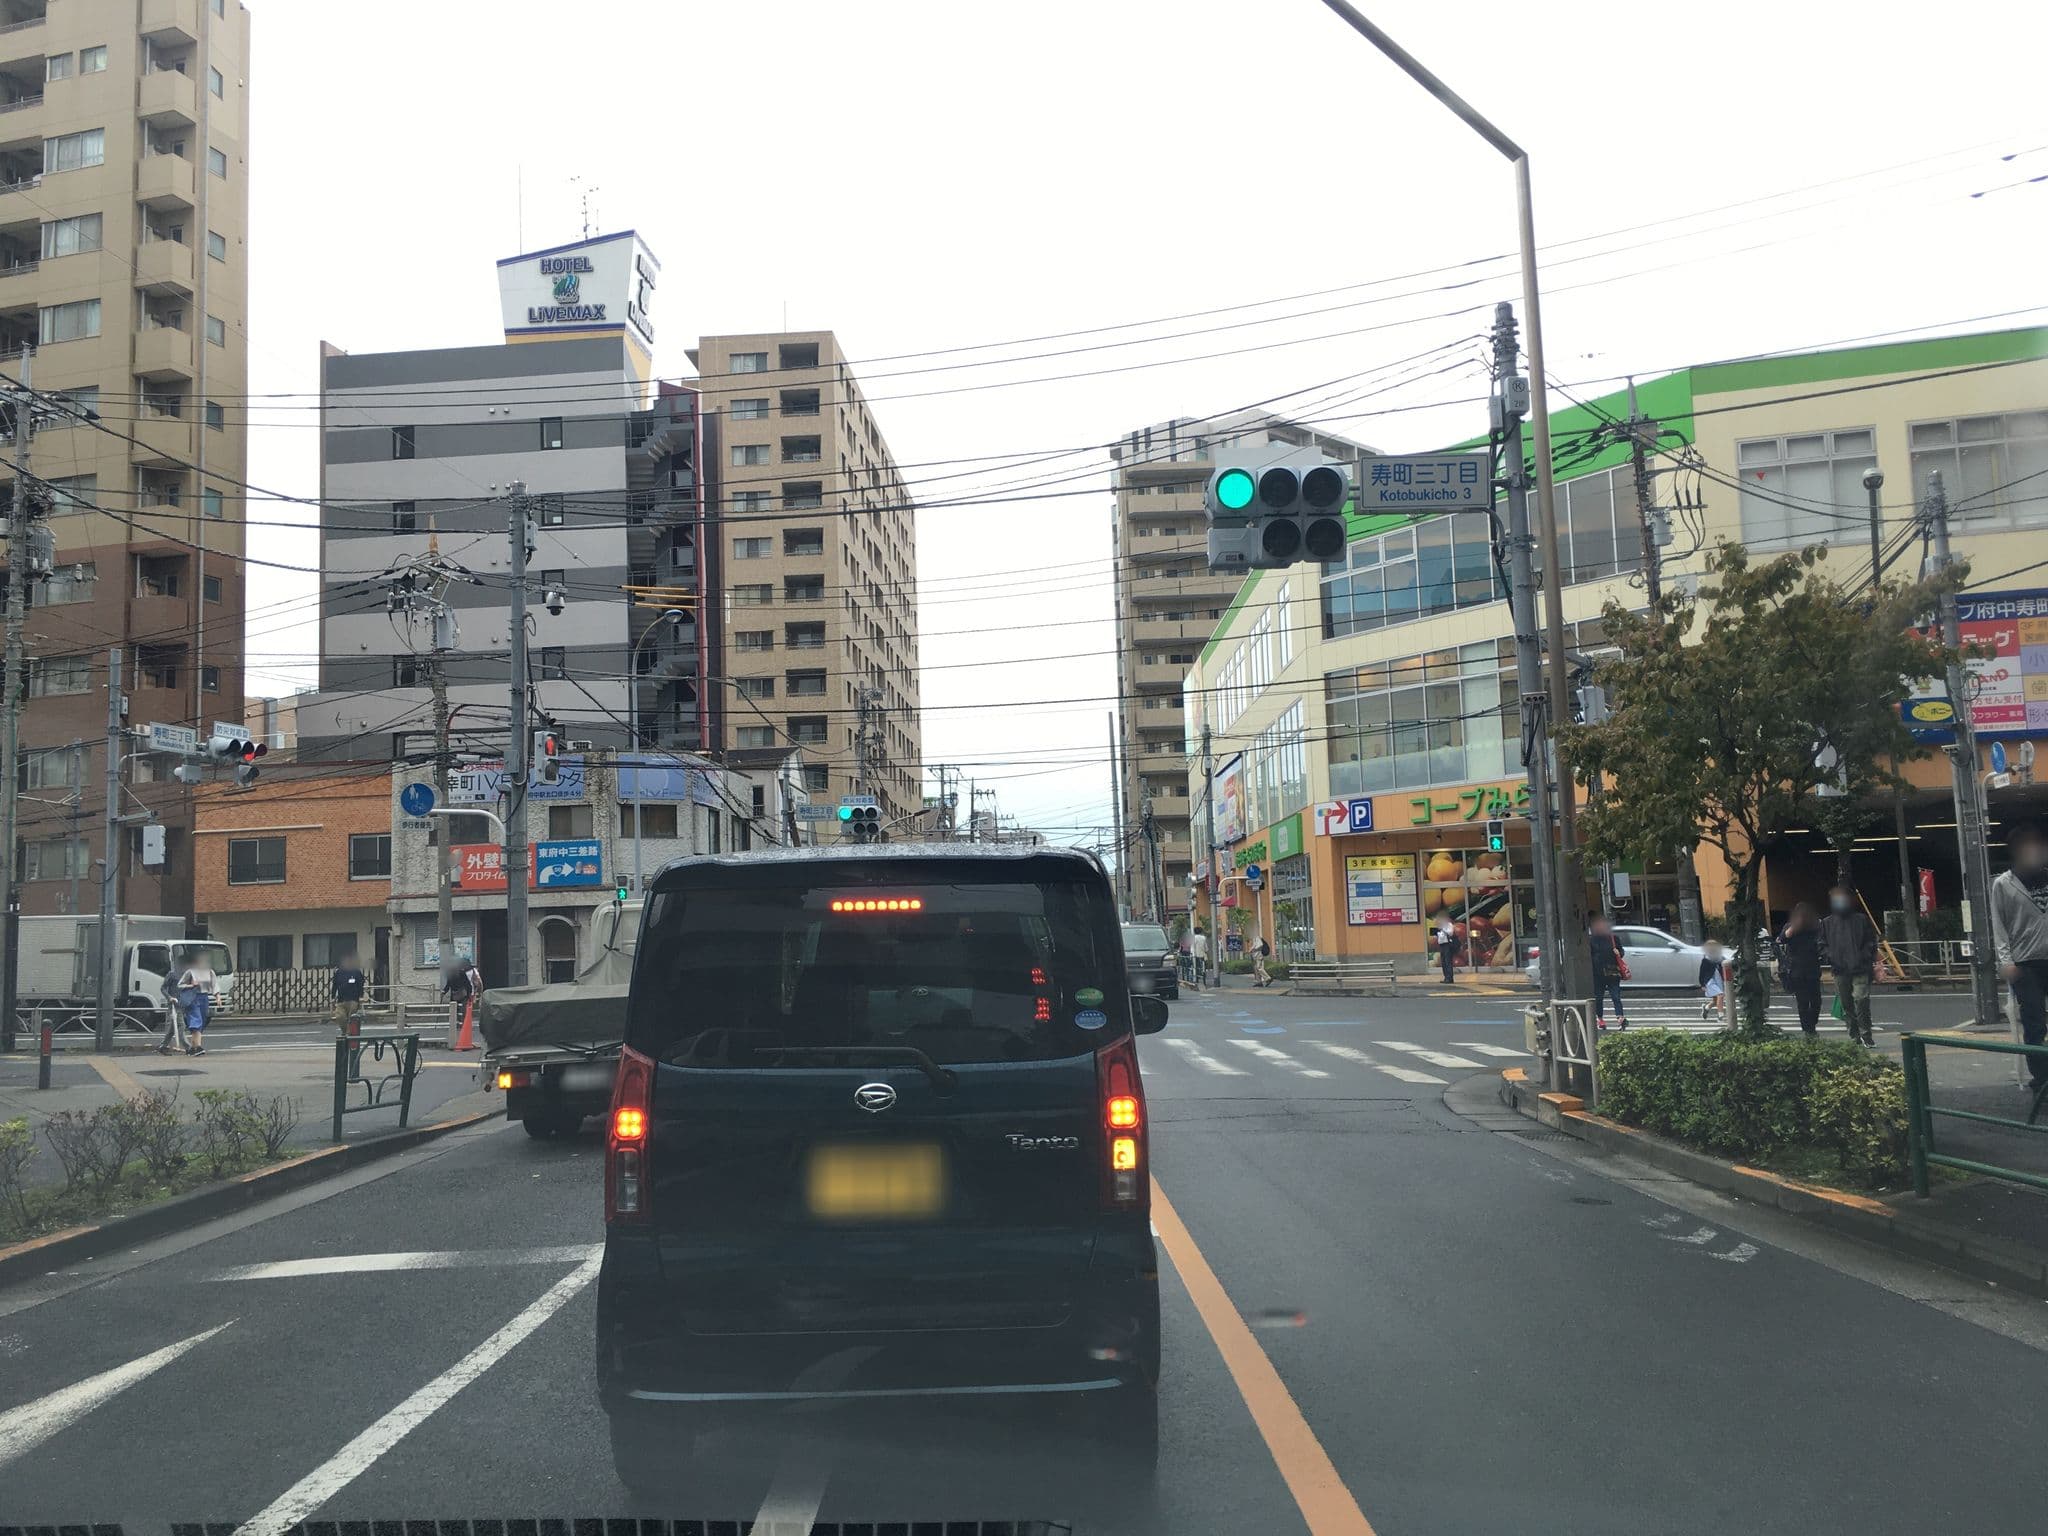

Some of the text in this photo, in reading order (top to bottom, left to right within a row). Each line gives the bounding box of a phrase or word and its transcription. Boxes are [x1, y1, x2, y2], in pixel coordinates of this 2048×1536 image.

[541, 257, 594, 274] HOTEL
[1371, 461, 1478, 487] 寿町三丁目
[1380, 487, 1472, 502] Kotobukicho 3
[1005, 1134, 1079, 1149] Tanto
